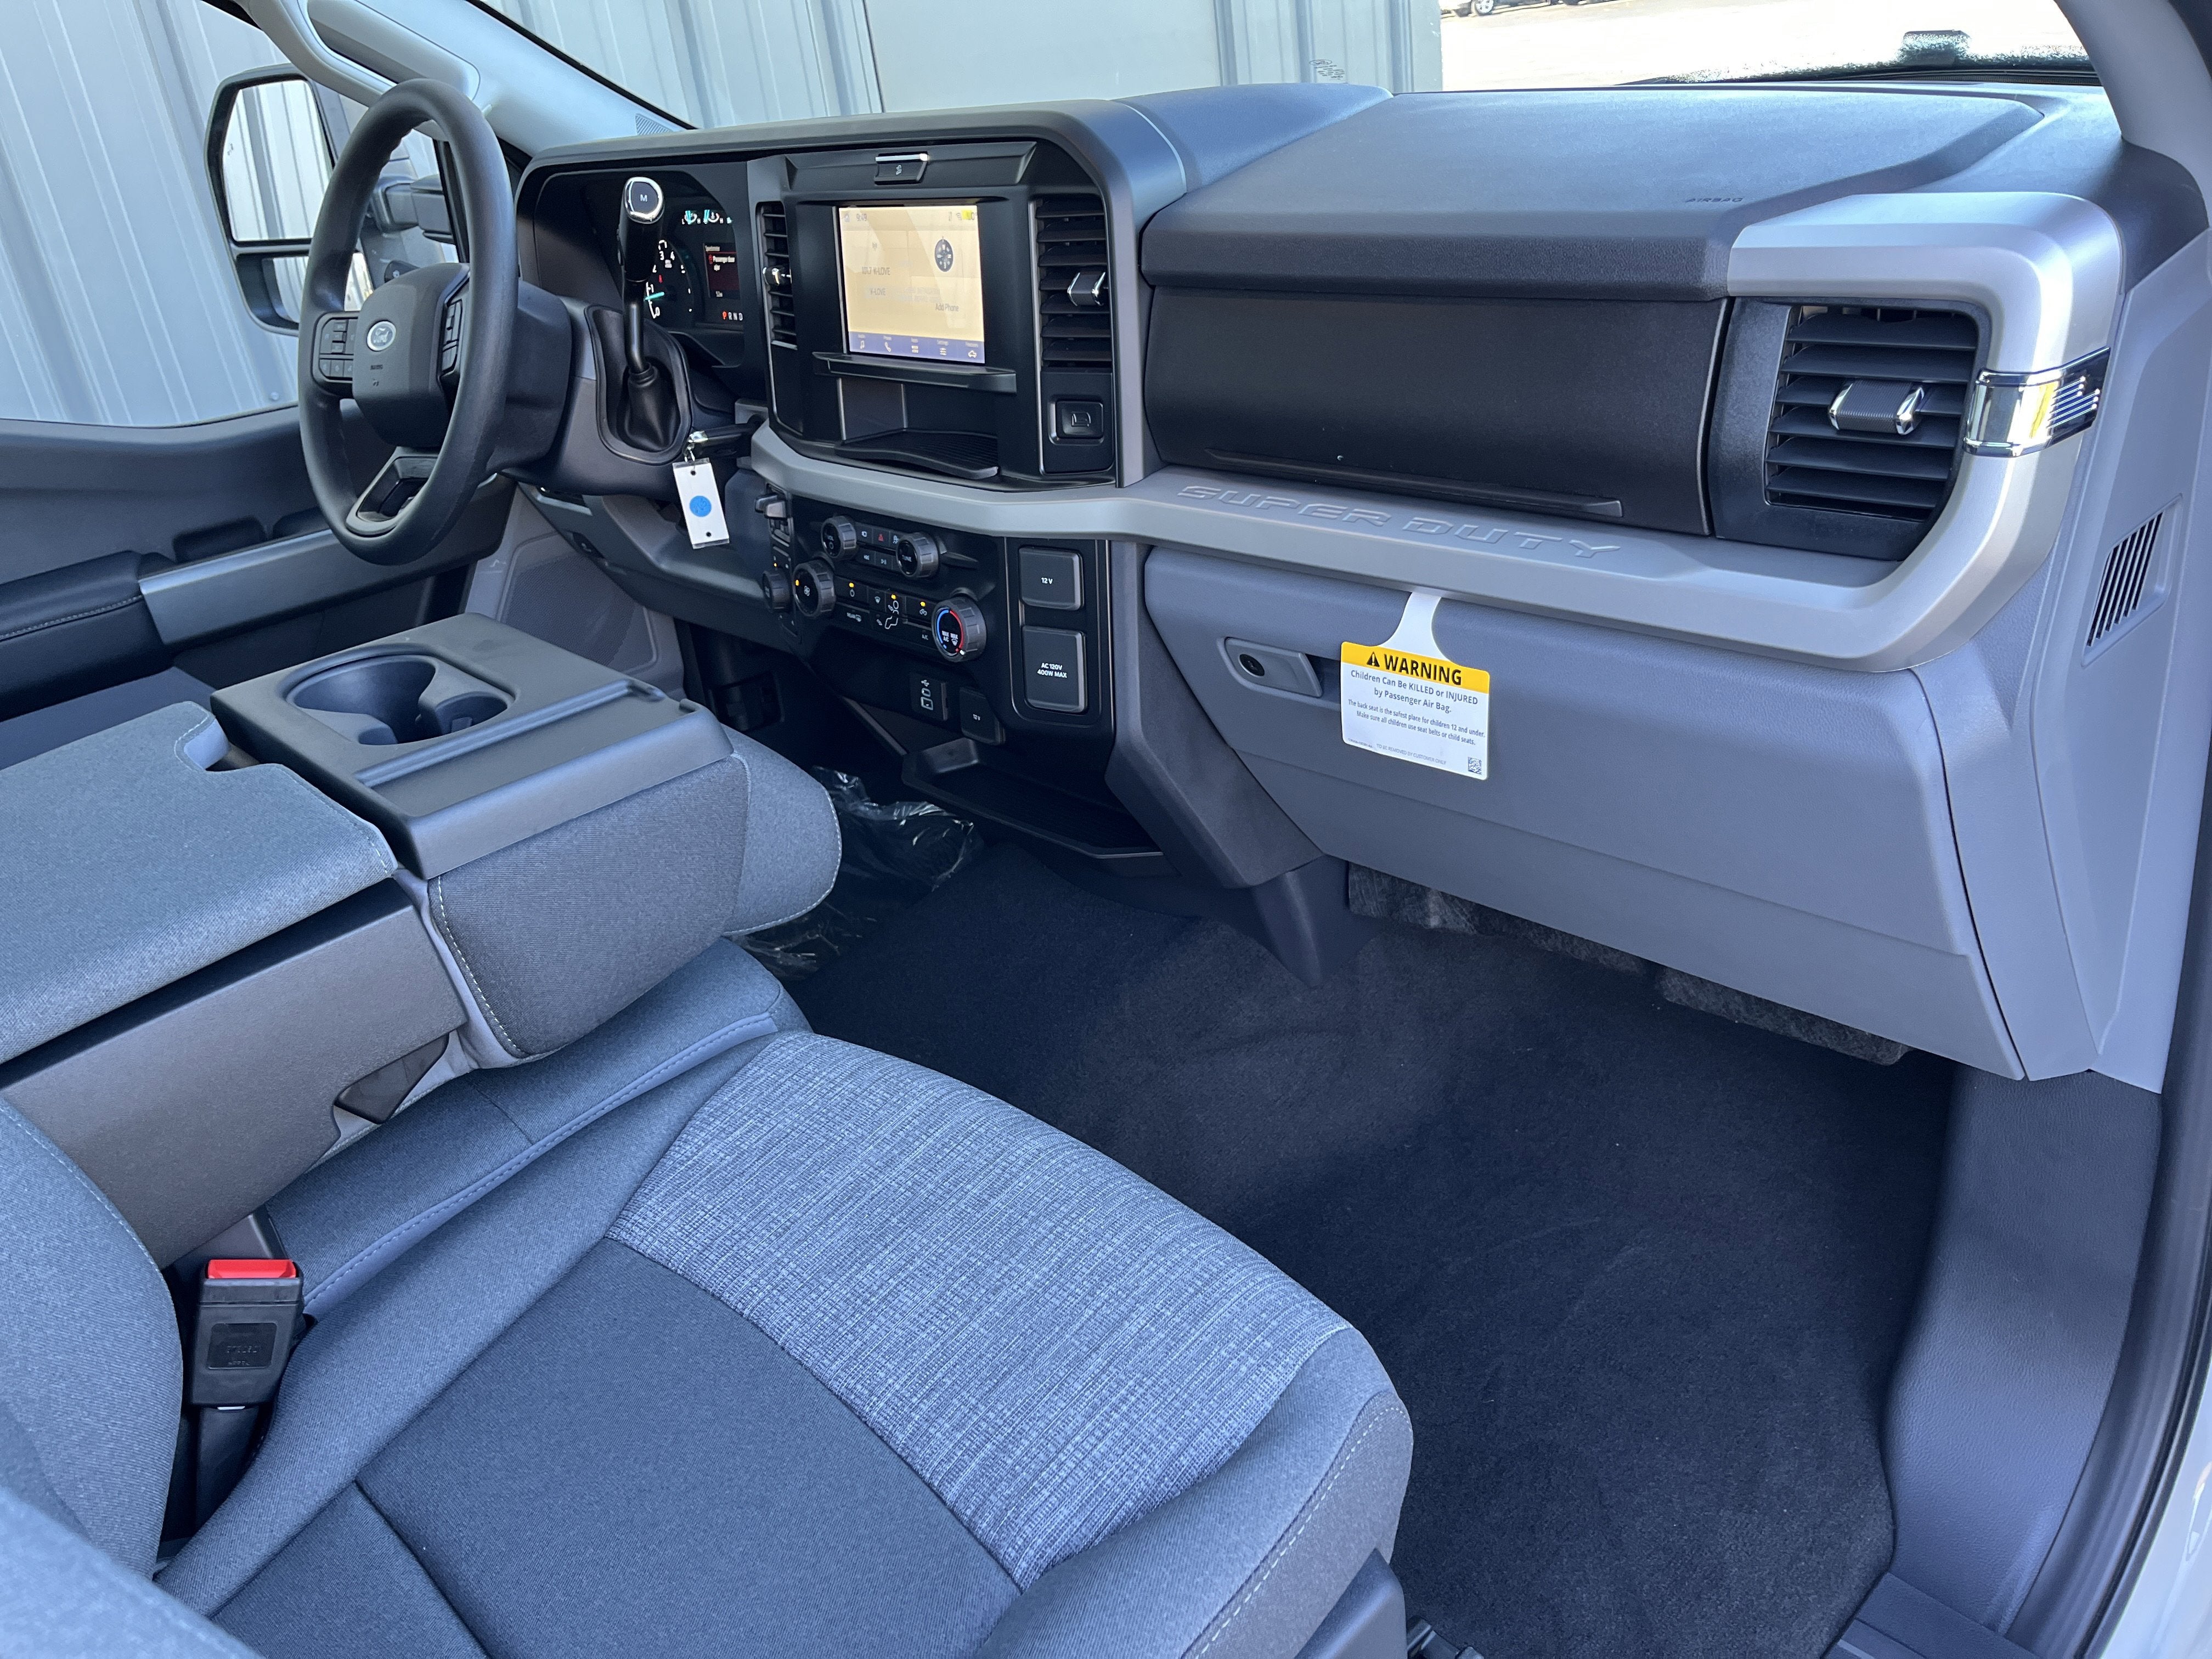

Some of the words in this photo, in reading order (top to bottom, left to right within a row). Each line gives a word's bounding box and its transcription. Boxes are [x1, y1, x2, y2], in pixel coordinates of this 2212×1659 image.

[1177, 486, 1392, 527] SUPER
[1402, 517, 1621, 558] DUTY
[1351, 669, 1380, 683] Children
[1382, 676, 1396, 686] Can
[1398, 680, 1407, 689] Be
[1409, 682, 1434, 695] KILLED
[1446, 691, 1478, 704] INJURED
[1384, 653, 1462, 686] WARNING
[1348, 698, 1357, 707] The
[1357, 701, 1368, 709] back
[1393, 710, 1407, 719] safest
[1408, 714, 1421, 722] place
[1430, 719, 1450, 729] children
[1469, 729, 1486, 738] under.
[1374, 687, 1383, 698] by
[1384, 690, 1421, 706] Passenger
[1423, 699, 1434, 708] Air
[1436, 702, 1452, 714] Bag.
[1356, 710, 1369, 719] Make
[1388, 718, 1407, 729] children
[1429, 728, 1441, 737] belts
[1448, 733, 1460, 741] child
[1461, 736, 1476, 746] seats.
[1388, 747, 1407, 755] REMOVED
[1413, 753, 1435, 762] CUSTOMER
